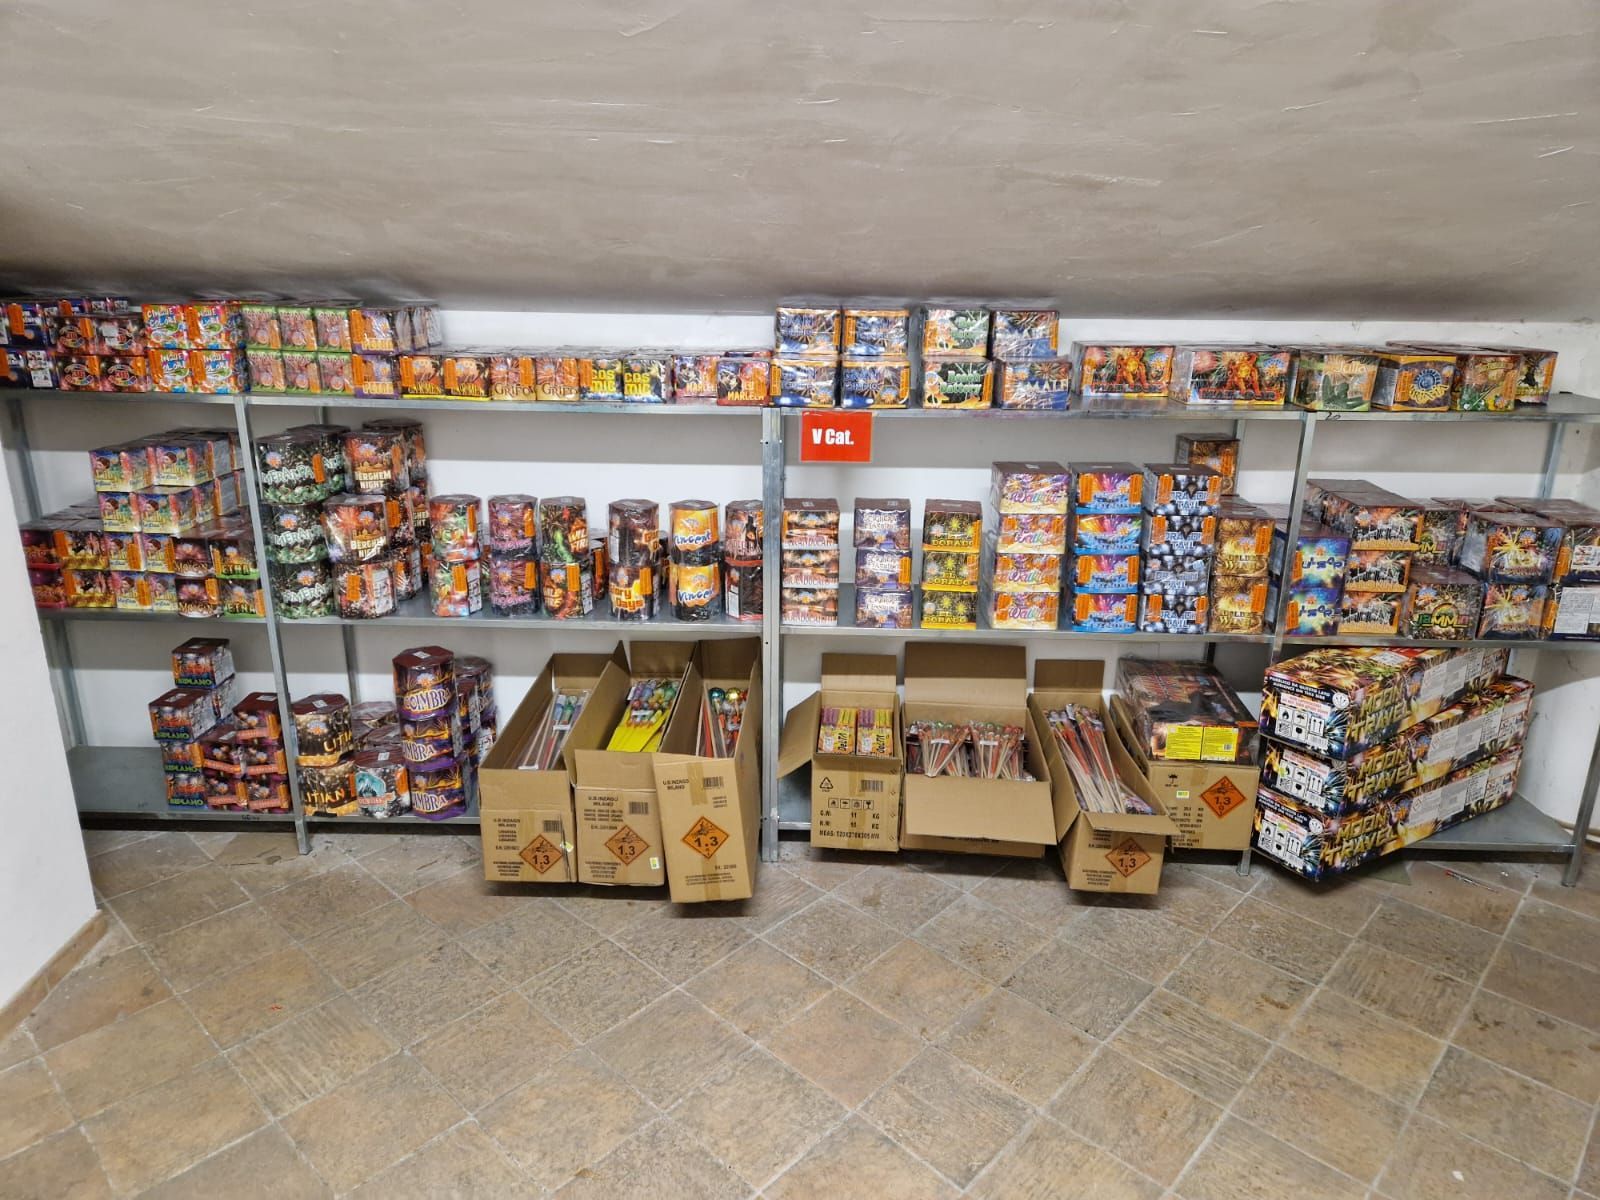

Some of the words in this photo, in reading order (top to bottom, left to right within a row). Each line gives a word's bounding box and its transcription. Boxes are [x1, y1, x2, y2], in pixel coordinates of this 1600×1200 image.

[812, 428, 822, 445] V
[825, 428, 855, 445] Cat.
[694, 836, 719, 848] 1.3
[618, 845, 635, 855] 1.3
[532, 855, 550, 865] 1.3
[1118, 857, 1136, 869] 1.3
